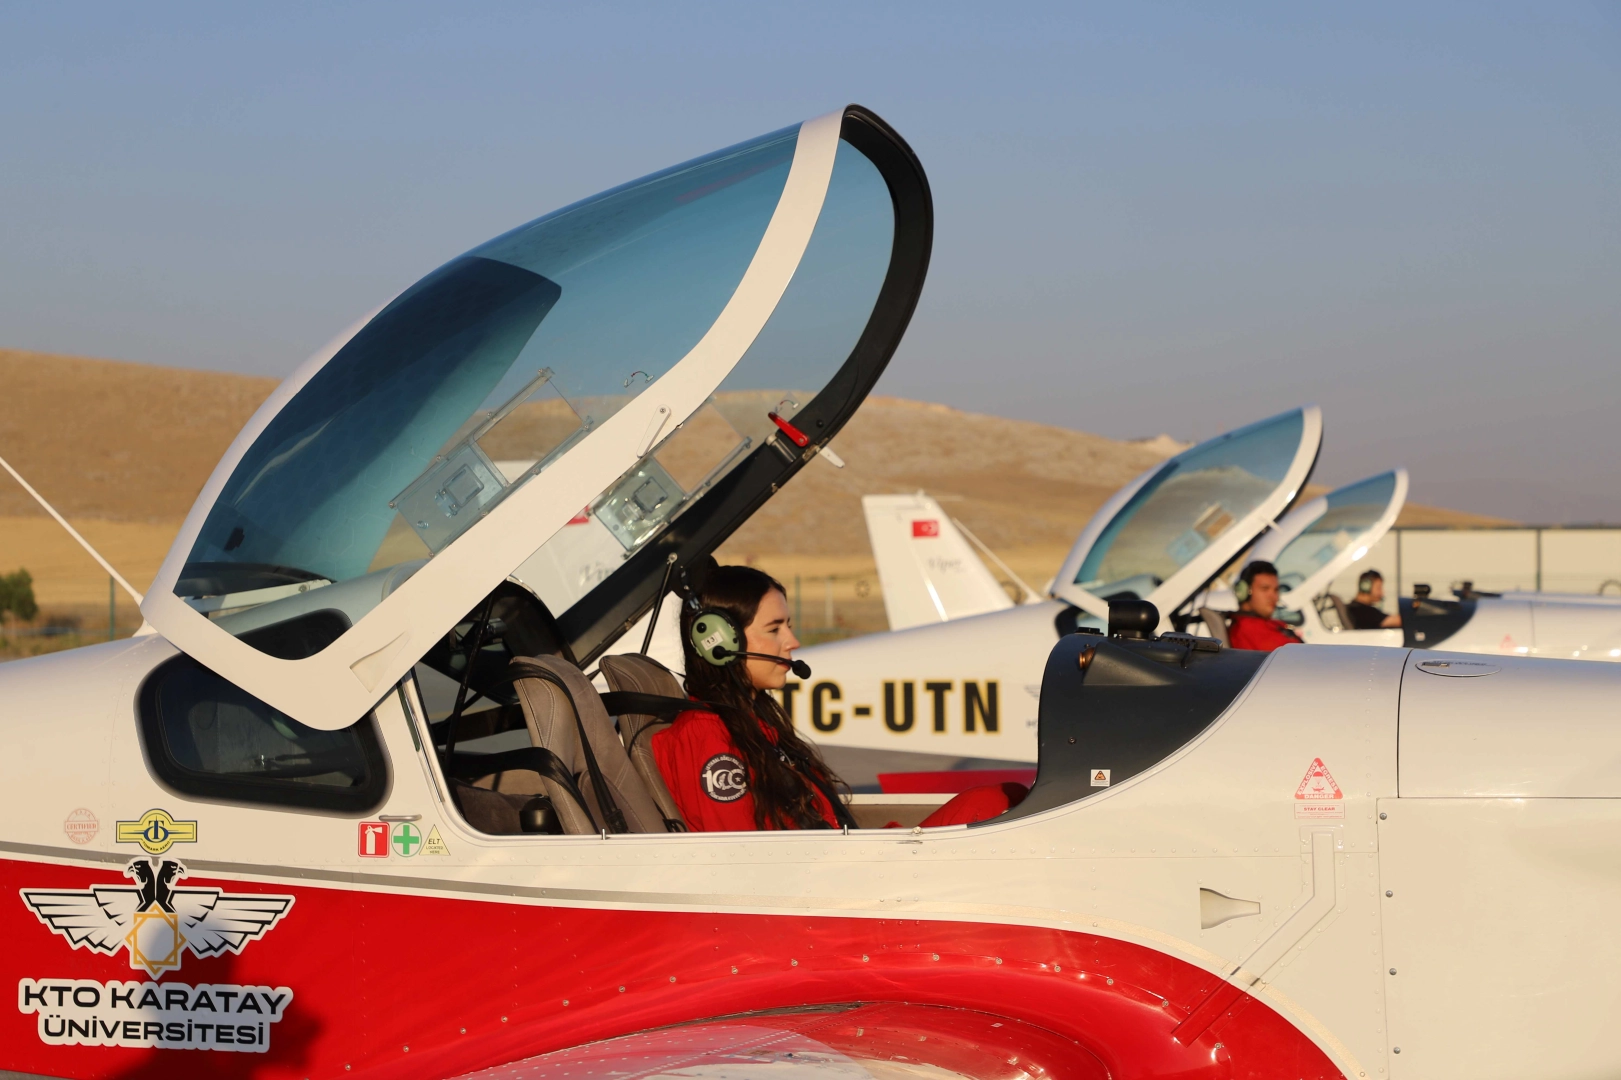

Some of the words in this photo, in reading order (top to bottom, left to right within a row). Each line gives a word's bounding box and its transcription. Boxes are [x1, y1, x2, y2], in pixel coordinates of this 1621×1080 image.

[779, 680, 999, 734] TC-UTN
[1297, 761, 1318, 795] EXPLOSIVE
[1320, 765, 1338, 791] EGRESS
[24, 985, 100, 1008] KTO
[111, 987, 286, 1015] KARATAY
[44, 1014, 264, 1045] ÜNİVERSİTESİ
